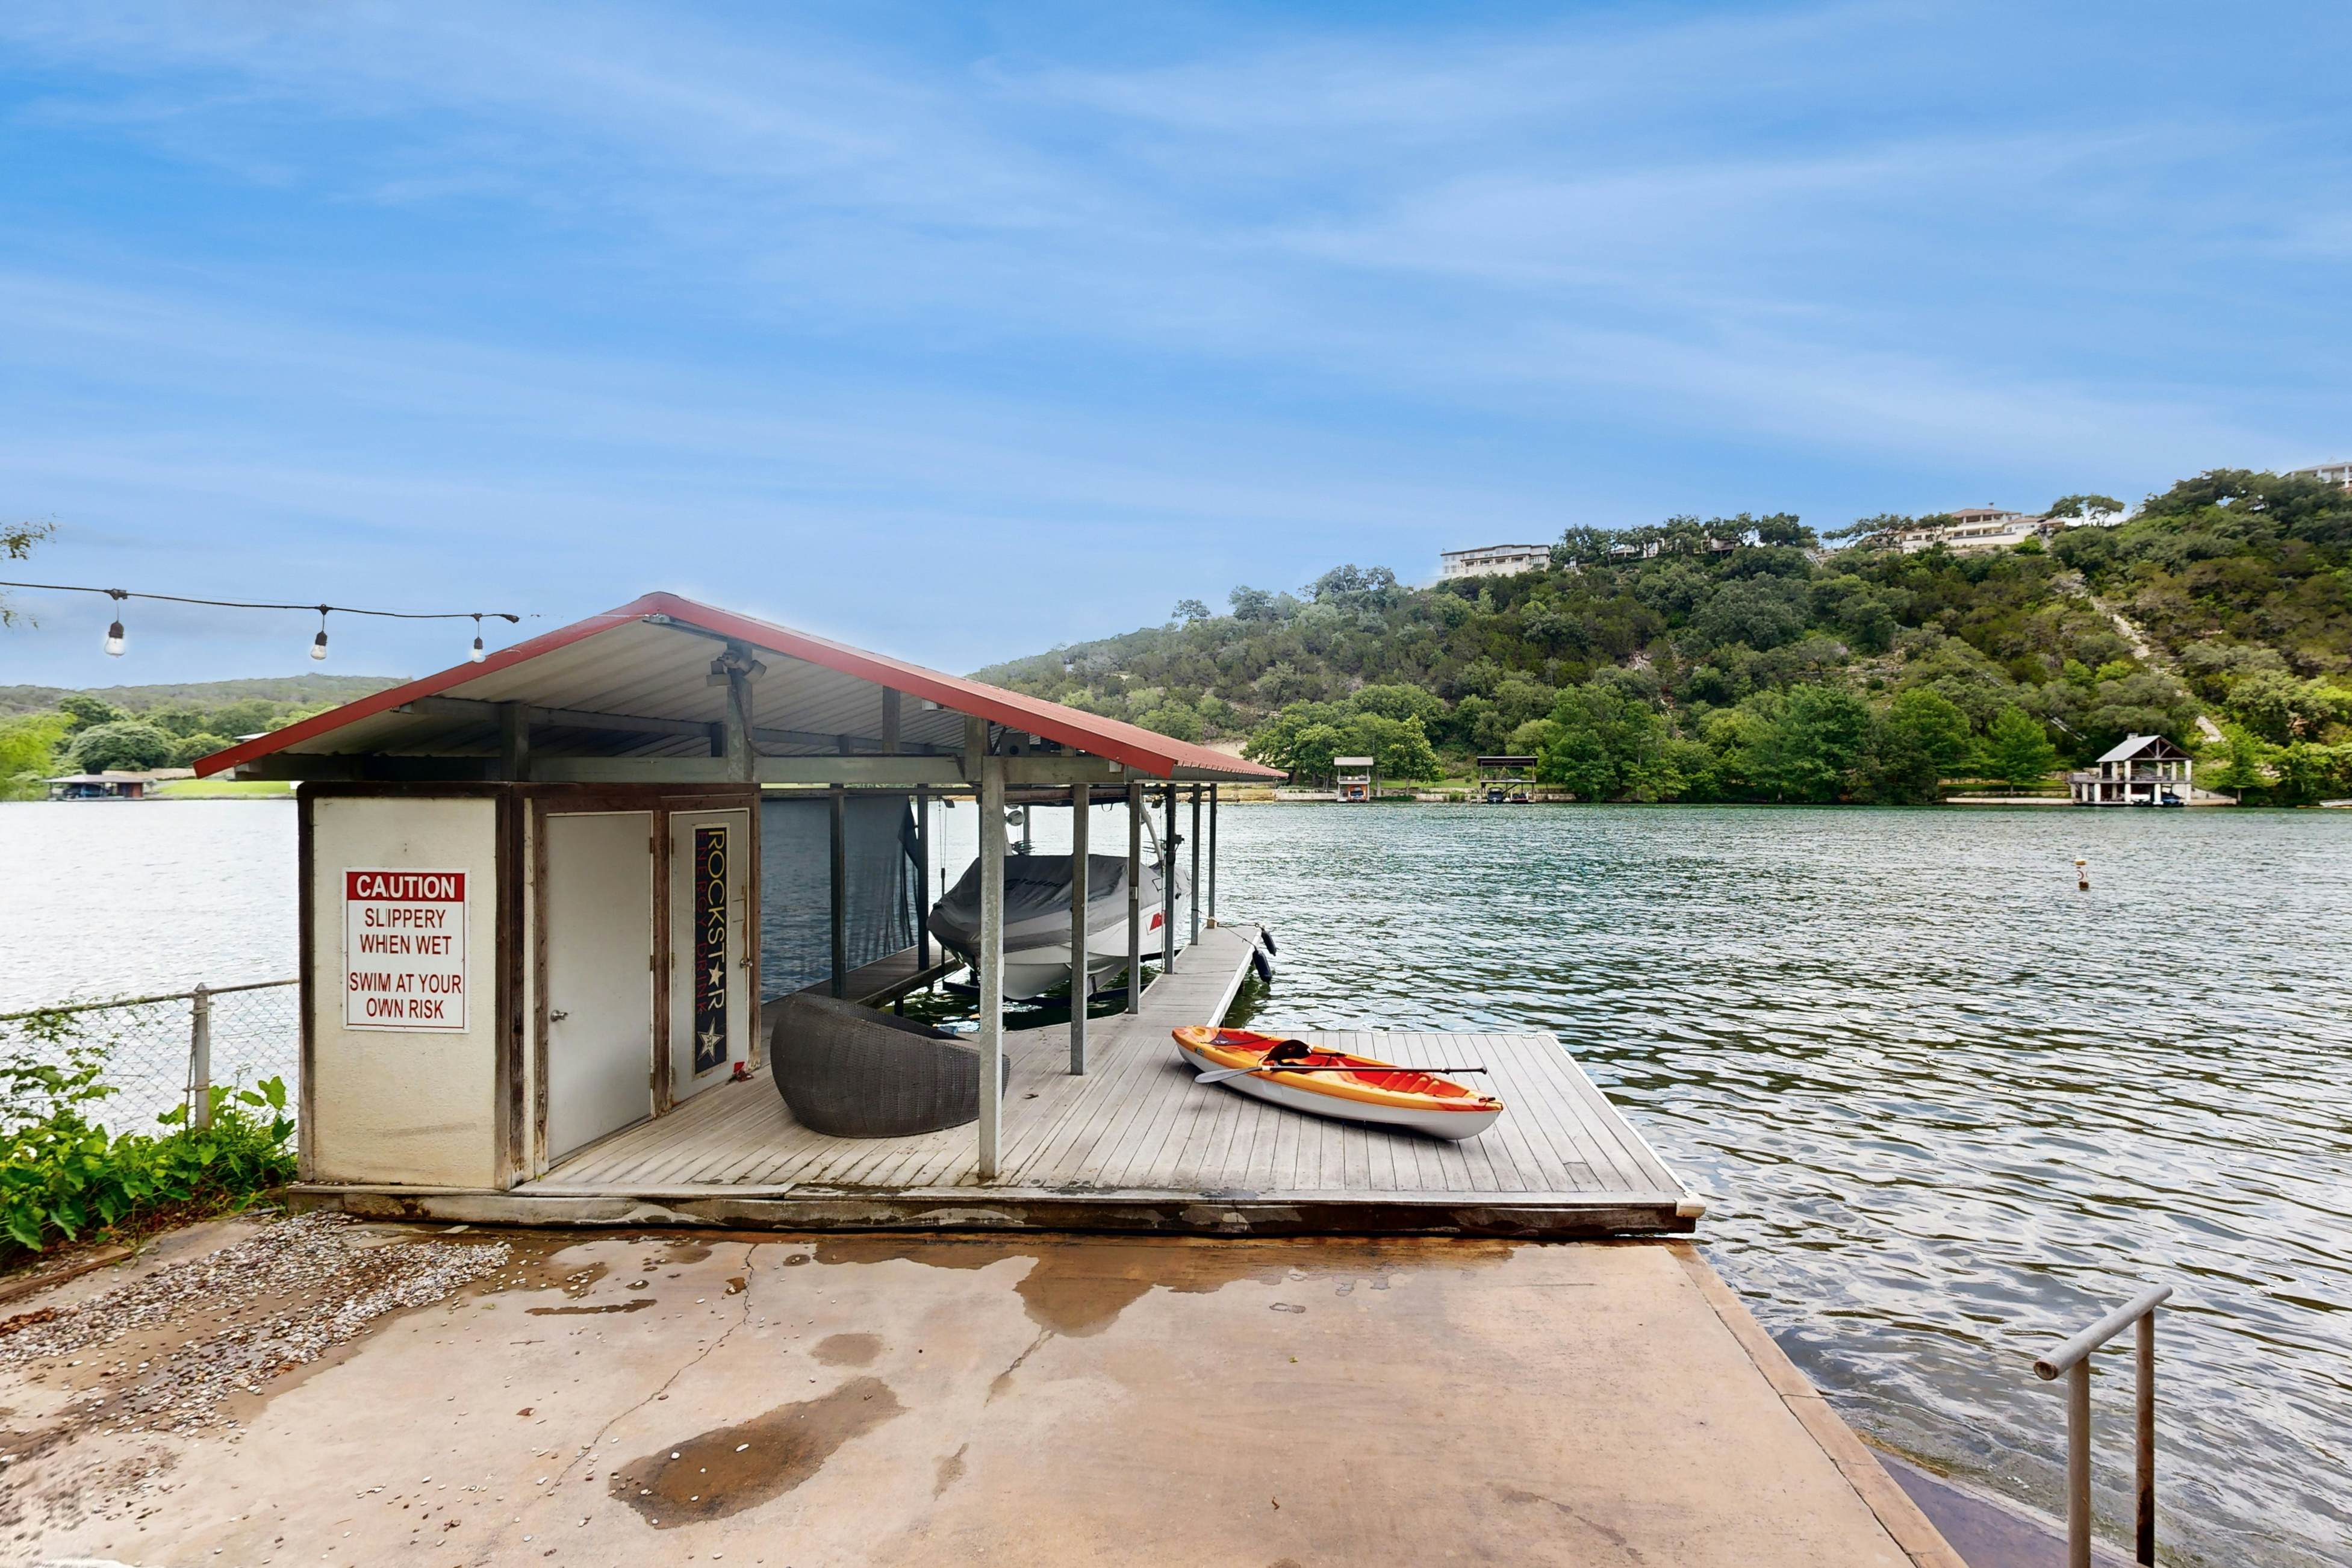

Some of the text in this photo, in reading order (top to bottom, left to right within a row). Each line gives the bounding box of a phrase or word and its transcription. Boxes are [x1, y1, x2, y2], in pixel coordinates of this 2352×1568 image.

[356, 875, 455, 898] CAUTION
[365, 907, 446, 928] SLIPPERY
[697, 832, 708, 1012] ENERGY DRINK
[359, 934, 452, 955] WHEN WET
[349, 972, 462, 994] SWIM AT YOUR
[366, 998, 444, 1019] OWN RISK
